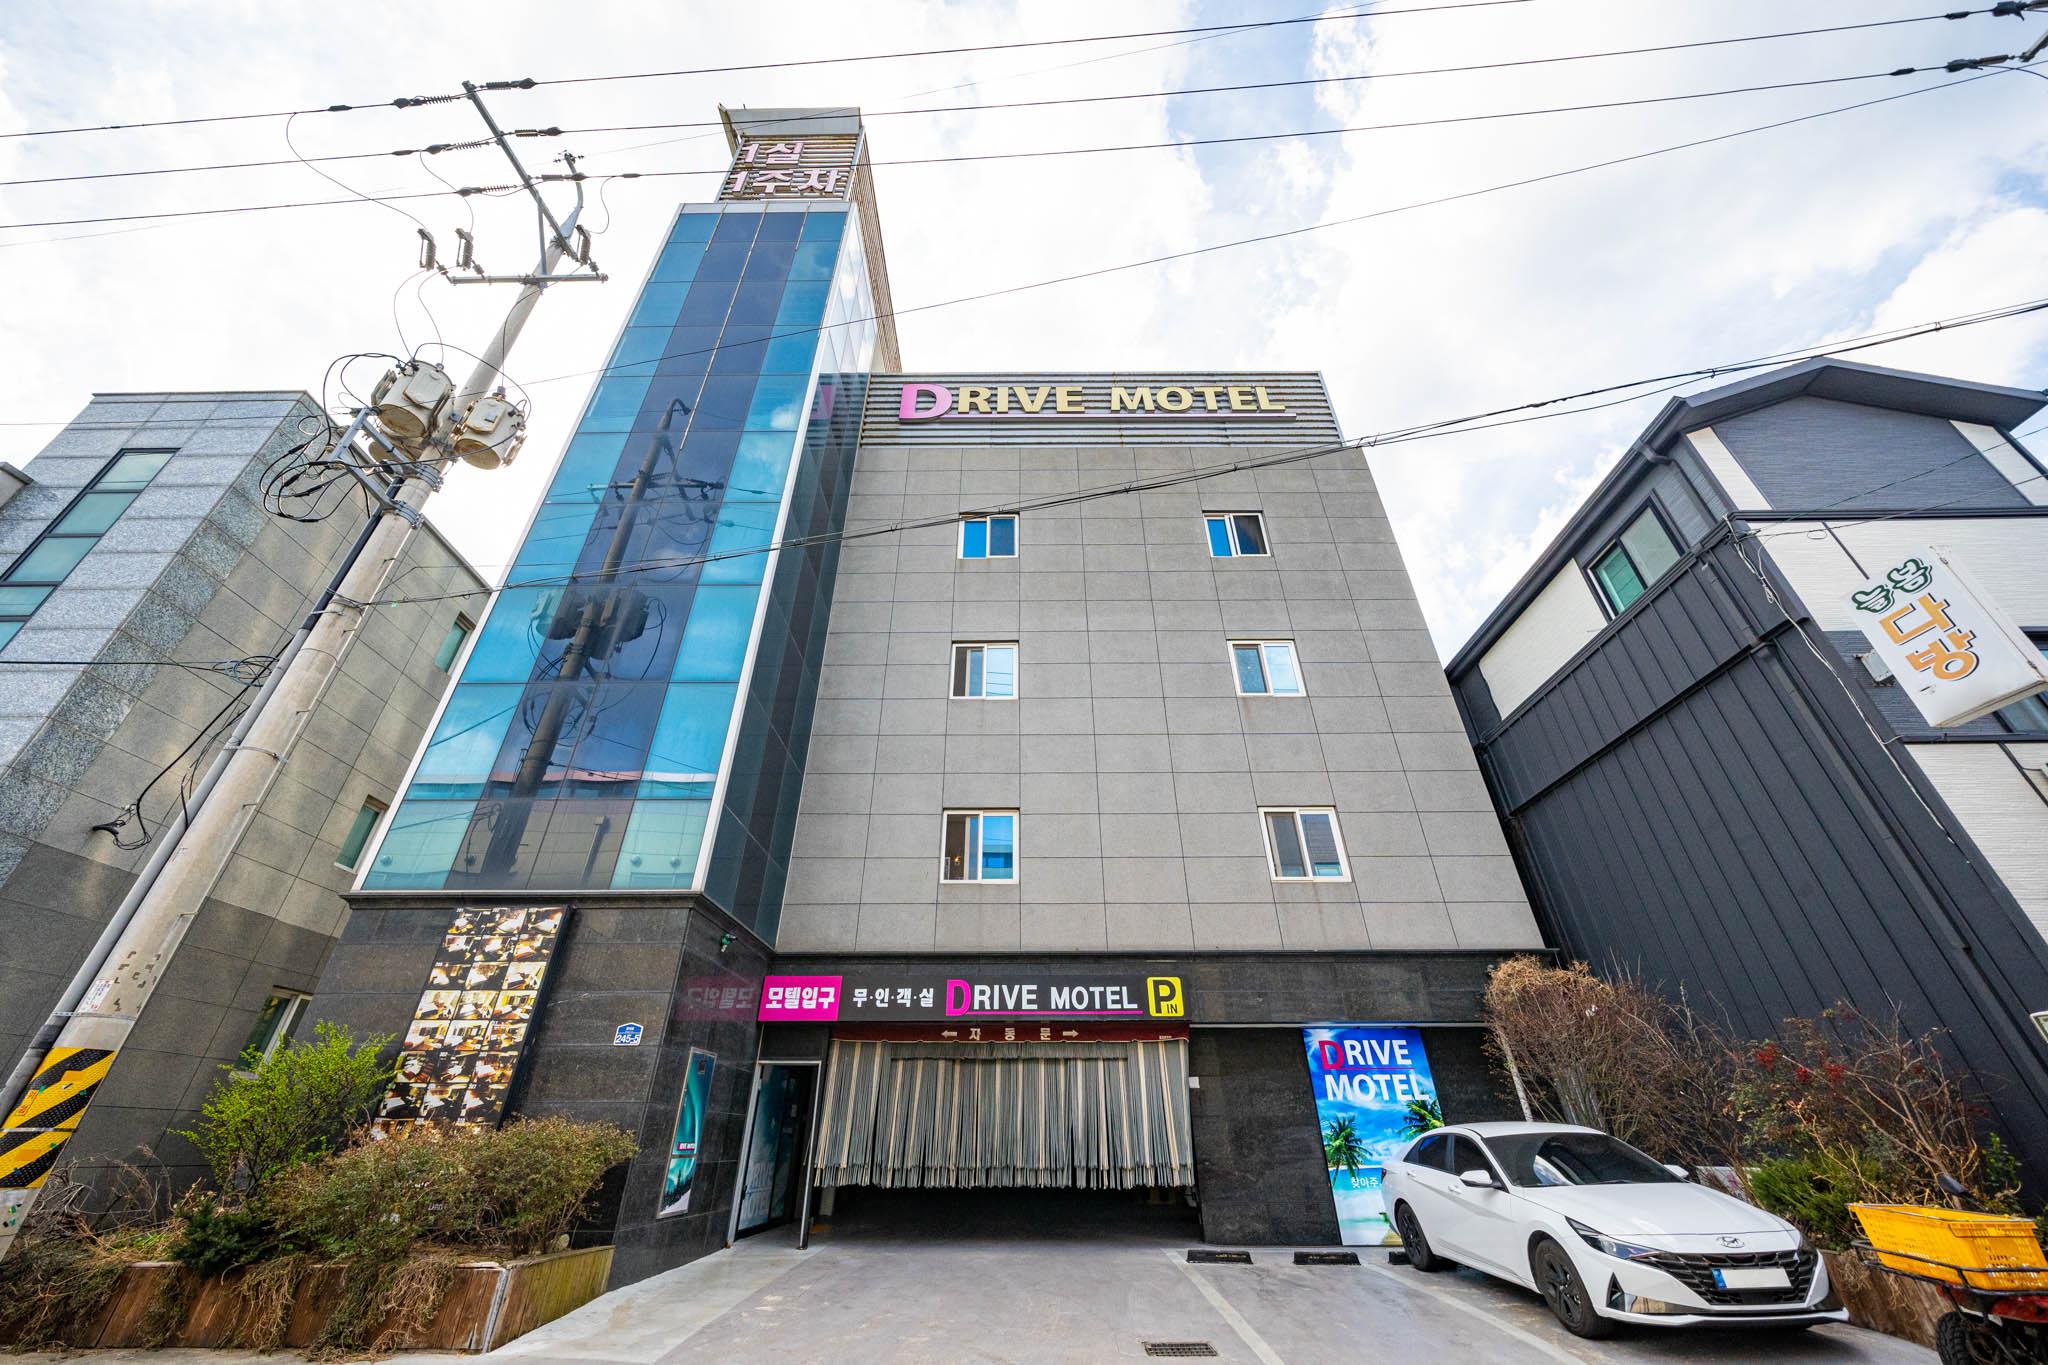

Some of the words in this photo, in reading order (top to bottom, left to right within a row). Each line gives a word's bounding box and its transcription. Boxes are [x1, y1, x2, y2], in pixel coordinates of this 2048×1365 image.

[742, 143, 804, 166] 1실
[898, 383, 1085, 420] DRIVE
[1110, 386, 1286, 413] MOTEL
[1878, 593, 1980, 681] 다방
[765, 986, 836, 1009] 모텔입구
[946, 979, 1038, 1016] DRIVE
[1050, 985, 1138, 1010] MOTEL
[1151, 979, 1178, 1014] P
[1166, 1003, 1178, 1014] IN
[615, 1034, 640, 1044] 245-5
[1318, 1039, 1412, 1070] DRIVE
[1324, 1073, 1431, 1102] MOTEL
[1351, 1176, 1380, 1189] 찾아주
